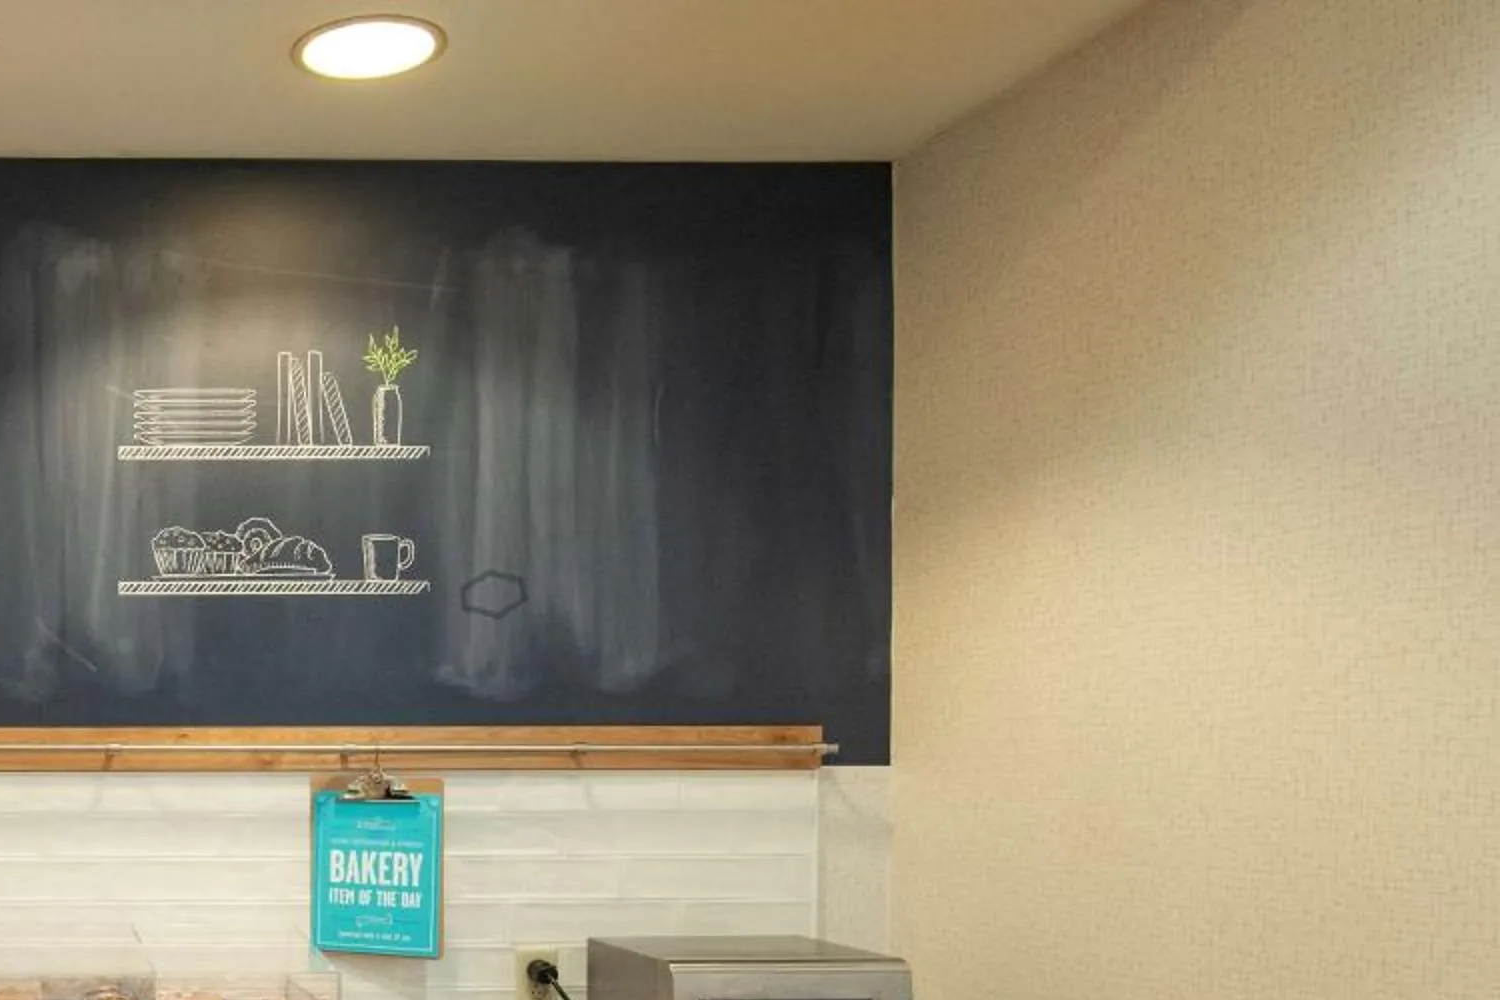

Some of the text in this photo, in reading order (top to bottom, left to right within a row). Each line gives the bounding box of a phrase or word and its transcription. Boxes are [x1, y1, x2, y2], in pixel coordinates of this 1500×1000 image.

[329, 849, 423, 887] BAKERY
[329, 887, 423, 908] ITEM OF THE DAY
